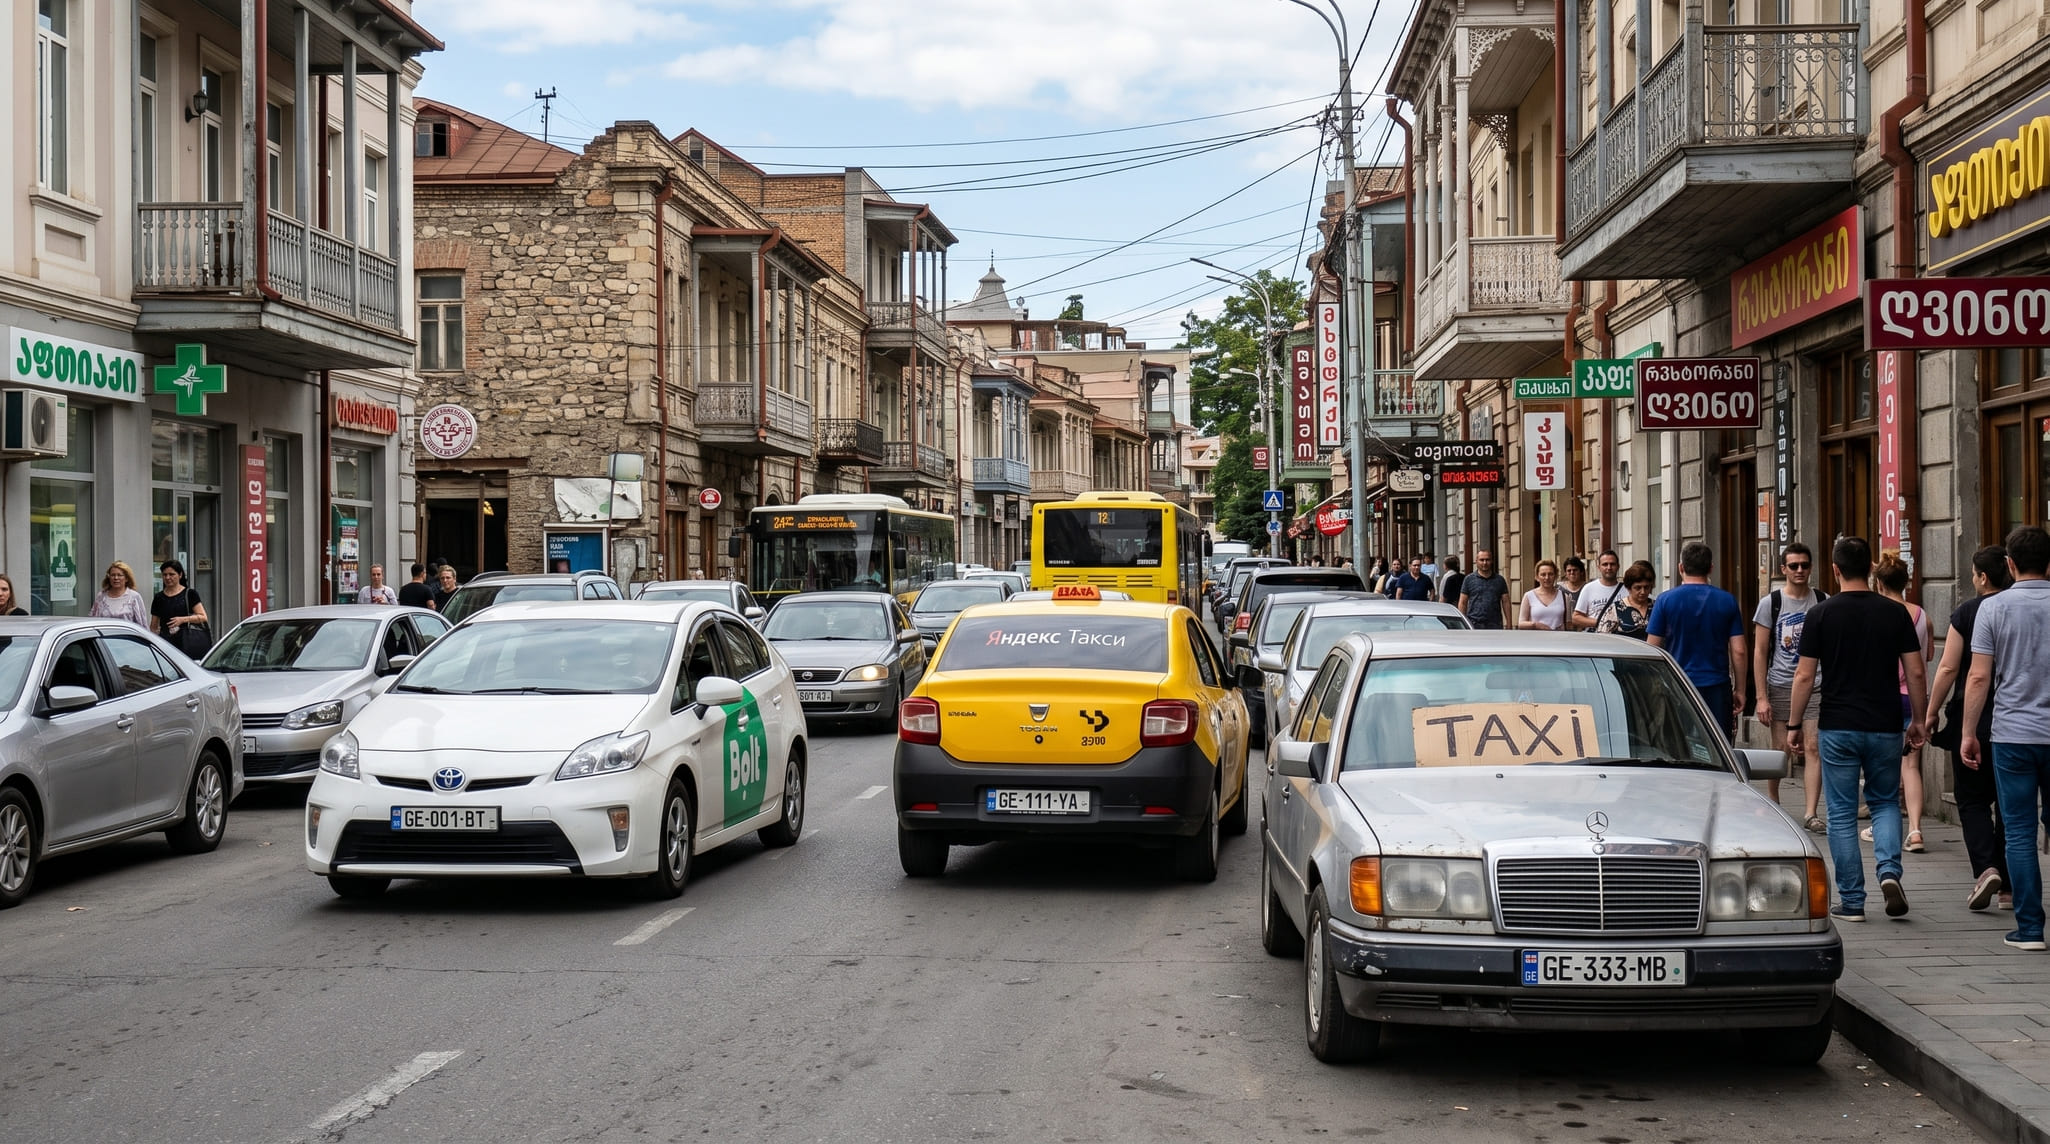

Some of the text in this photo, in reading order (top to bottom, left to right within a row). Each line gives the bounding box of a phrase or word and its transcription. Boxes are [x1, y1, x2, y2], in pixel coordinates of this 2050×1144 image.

[1738, 226, 1849, 334] რესტორანი
[1880, 288, 2050, 339] ღვინო
[17, 337, 136, 393] აფთიაქი
[1647, 391, 1755, 421] ღვინო
[1098, 511, 1108, 524] 12
[986, 629, 1126, 647] Яндекс Такси
[730, 735, 760, 792] Bolt
[1543, 956, 1666, 982] GE-333-MB
